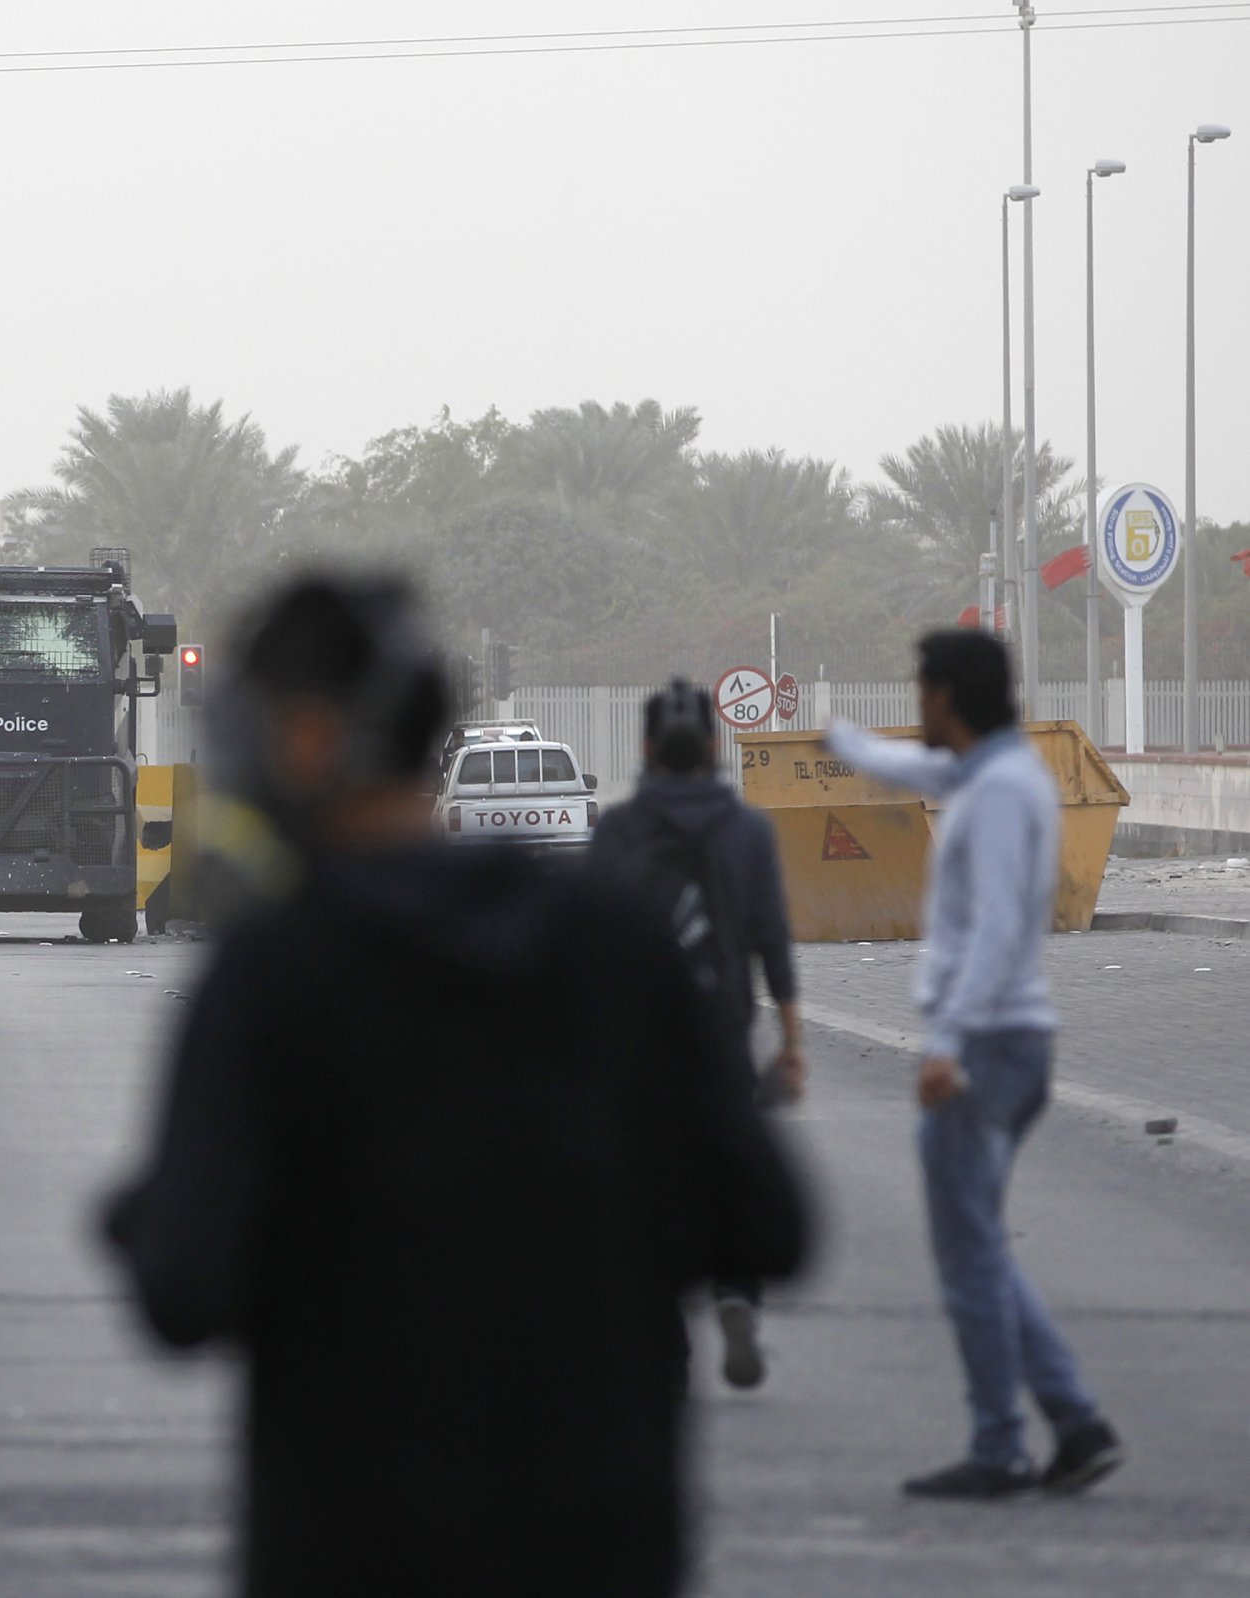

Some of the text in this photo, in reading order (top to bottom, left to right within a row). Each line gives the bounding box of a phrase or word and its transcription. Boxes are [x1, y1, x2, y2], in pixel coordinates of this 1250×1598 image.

[734, 703, 759, 721] 80
[776, 696, 797, 712] STOP
[475, 809, 572, 827] TOYOTA
